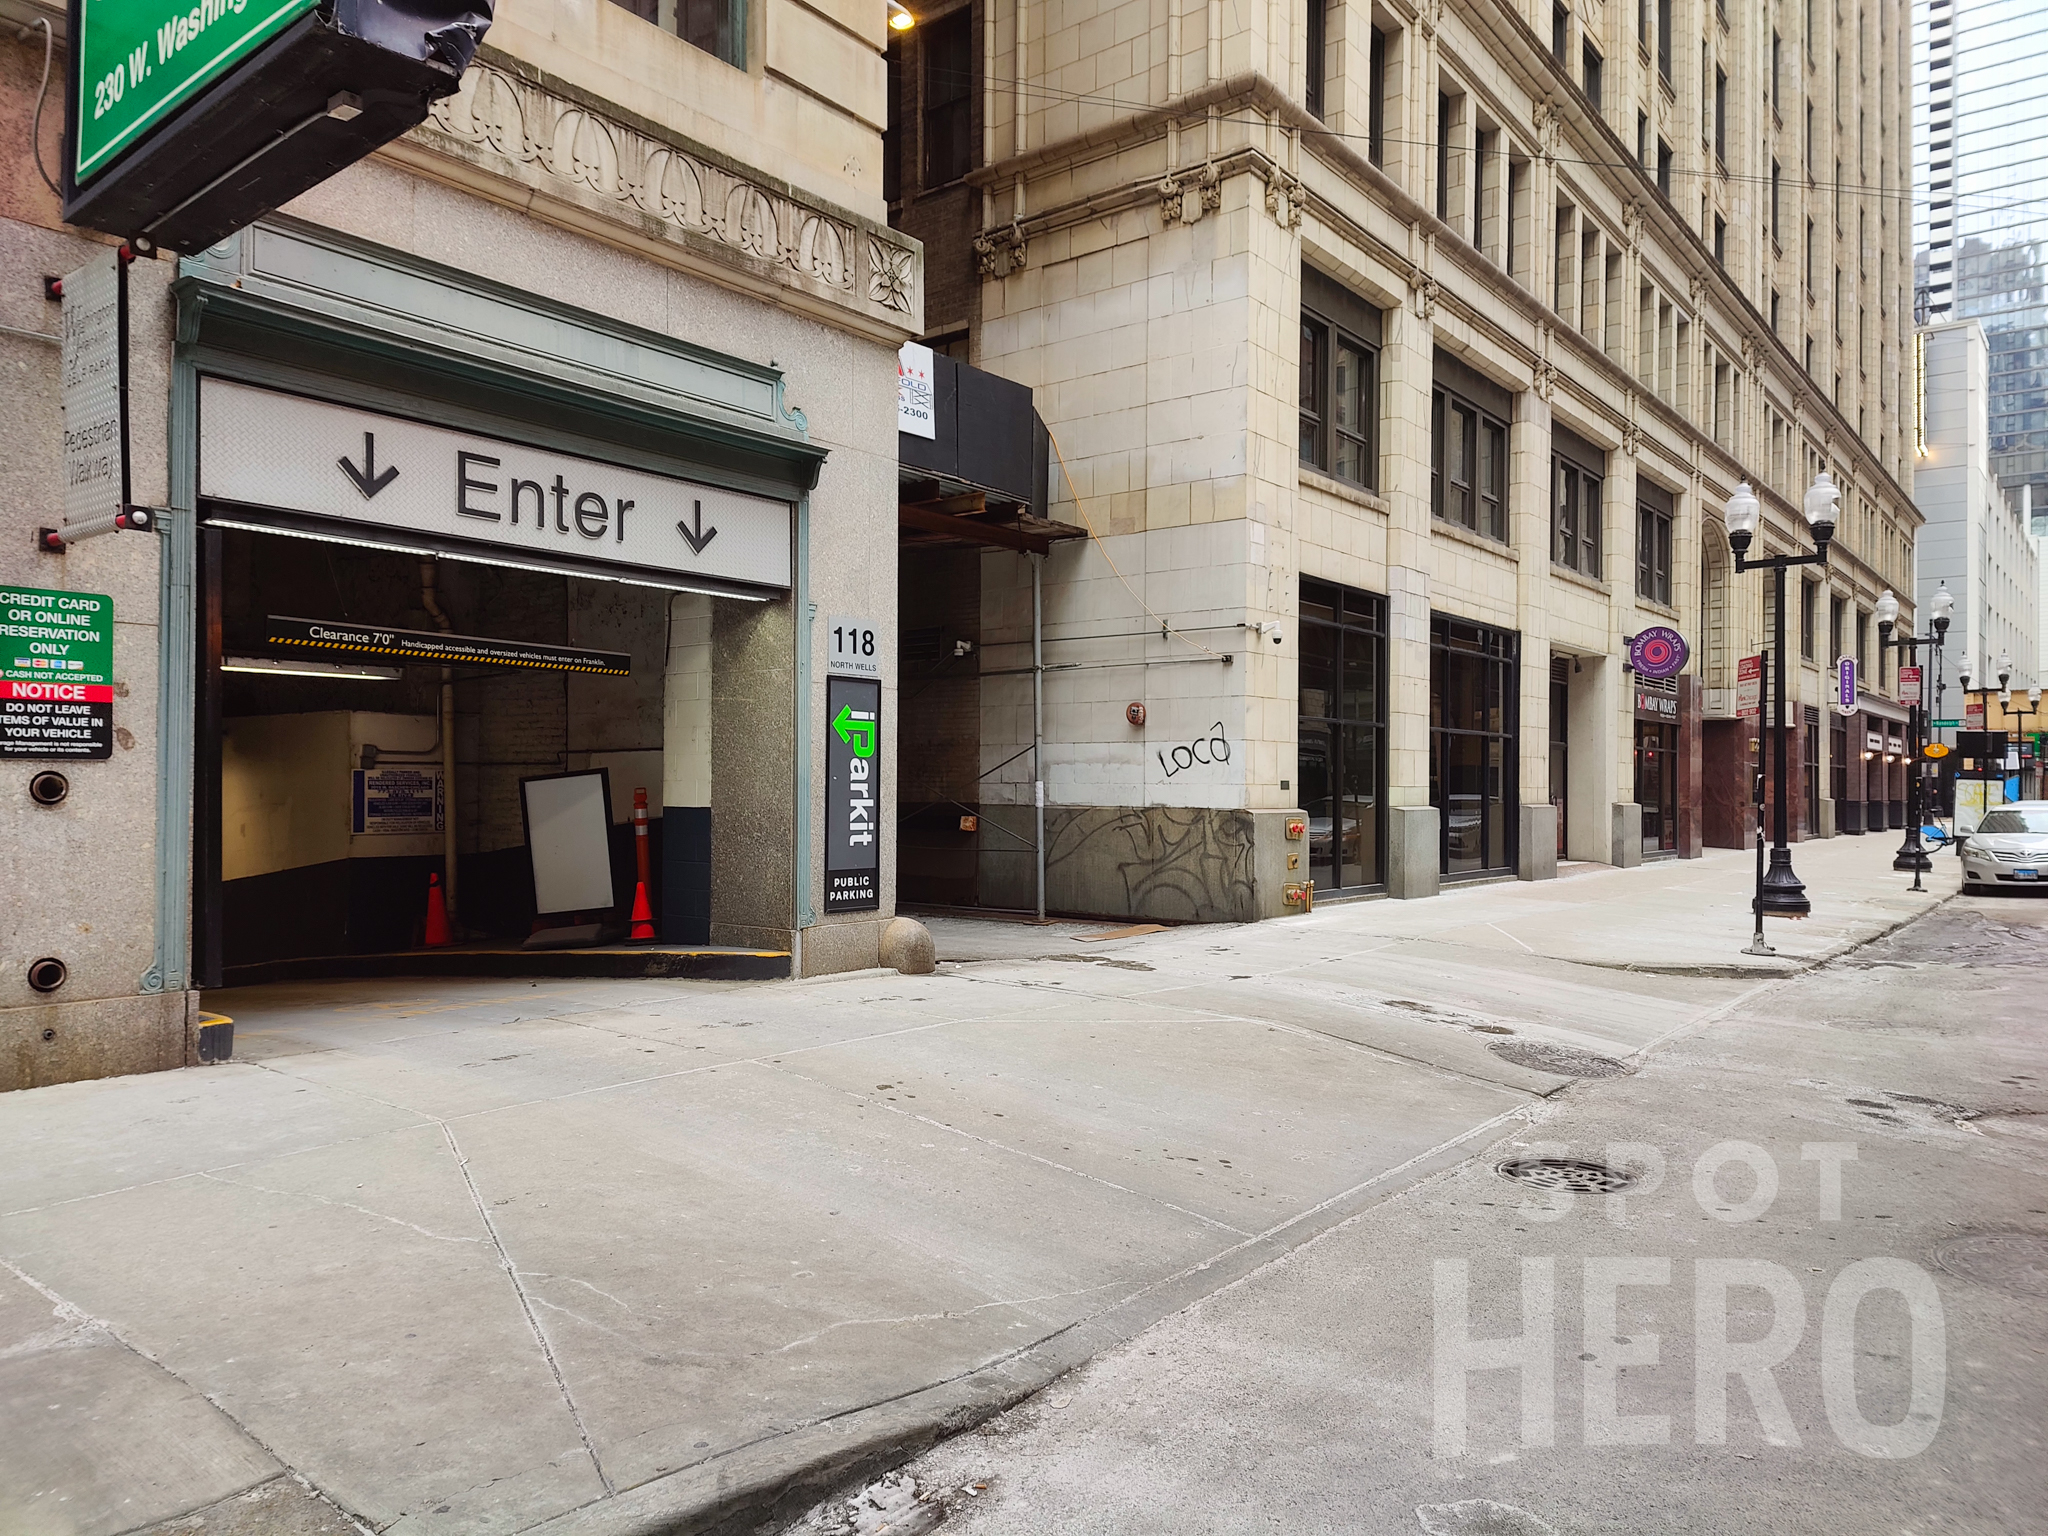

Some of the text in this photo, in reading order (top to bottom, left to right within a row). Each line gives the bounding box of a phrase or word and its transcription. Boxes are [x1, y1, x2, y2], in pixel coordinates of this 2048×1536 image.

[95, 64, 124, 120] 230
[129, 41, 151, 88] W.
[898, 405, 929, 420] -2300
[456, 449, 634, 542] Enter
[0, 592, 100, 612] CREDIT CARD
[8, 609, 91, 626] OR ONLINE
[0, 624, 100, 642] RESERVATION
[834, 626, 875, 656] 118
[29, 642, 70, 655] ONLY
[309, 626, 369, 643] Clearance
[401, 639, 444, 651] Handicapped
[445, 645, 476, 654] accessible
[477, 647, 489, 655] and
[489, 648, 518, 658] oversized
[519, 651, 542, 660] vehicles
[543, 654, 557, 662] must
[558, 656, 573, 664] enter
[1634, 630, 1681, 656] BOMBAY WRAPS
[831, 661, 877, 672] NORTH WELLS
[5, 669, 103, 682] CASH NOT ACCEPTED
[12, 682, 86, 700] NOTICE
[6, 703, 91, 715] DO NOT LEAVE
[1637, 693, 1678, 714] BOMBAY WRAPS
[32, 716, 50, 725] OF
[51, 716, 89, 727] VALUE
[91, 718, 103, 727] IN
[5, 728, 92, 739] YOUR VEHICLE
[15, 740, 53, 748] Management
[436, 771, 444, 830] WARNING
[834, 876, 870, 888] PUBLIC
[829, 888, 874, 901] PARKING
